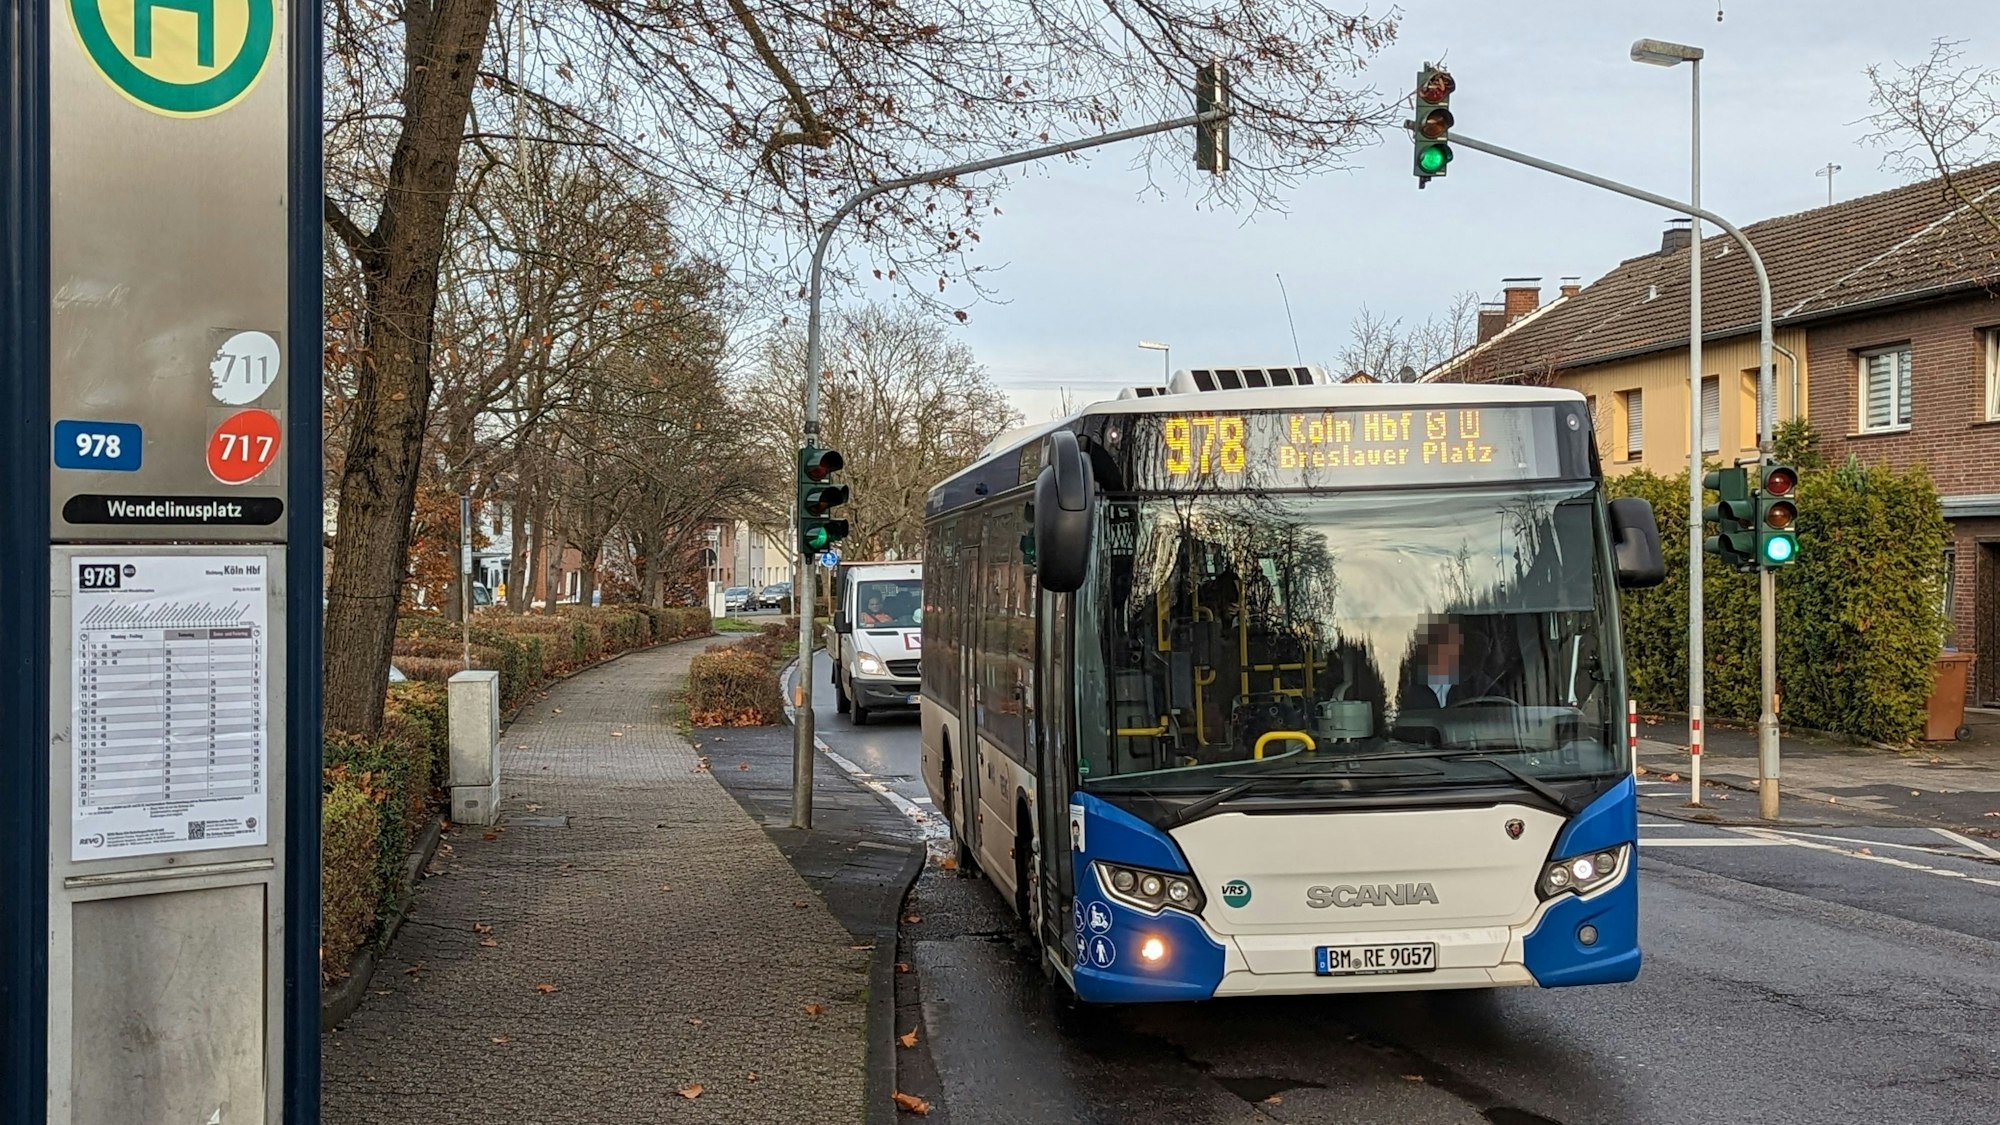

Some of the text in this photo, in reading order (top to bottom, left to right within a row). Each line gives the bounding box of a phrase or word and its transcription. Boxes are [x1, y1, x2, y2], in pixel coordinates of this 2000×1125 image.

[221, 354, 267, 384] 711
[1364, 412, 1412, 441] Hbf
[76, 433, 121, 458] 978
[219, 433, 273, 463] 717
[1165, 418, 1245, 474] 978
[1279, 441, 1492, 469] Breslauer Platz
[107, 500, 242, 521] Wendelinusplatz
[84, 566, 116, 586] 978
[224, 565, 244, 575] Köln
[246, 564, 260, 575] Hbf
[1221, 885, 1244, 895] VRS
[1305, 883, 1439, 908] SCANIA
[1328, 950, 1350, 968] BM
[1364, 948, 1385, 968] RE
[1390, 948, 1432, 966] 9057
